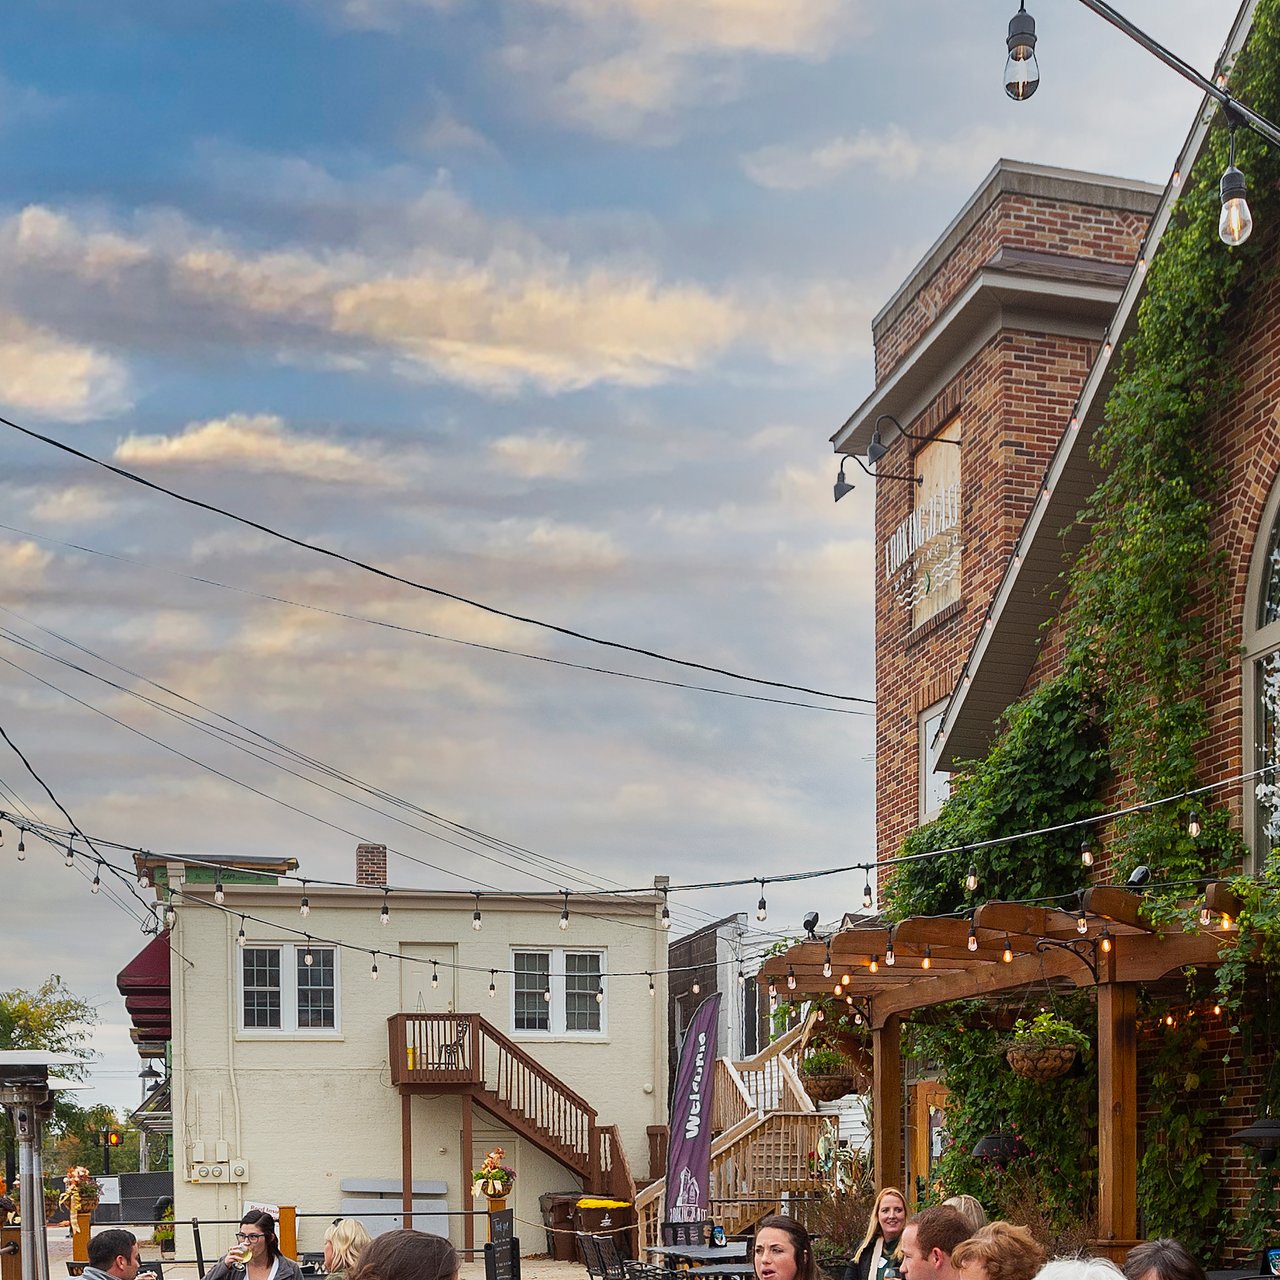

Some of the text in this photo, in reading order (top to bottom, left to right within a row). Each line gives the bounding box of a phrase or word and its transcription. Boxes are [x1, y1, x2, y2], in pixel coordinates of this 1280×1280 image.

[885, 480, 961, 581] LOOKING GLASS
[894, 543, 940, 592] BREWING
[685, 1032, 706, 1139] Welcome
